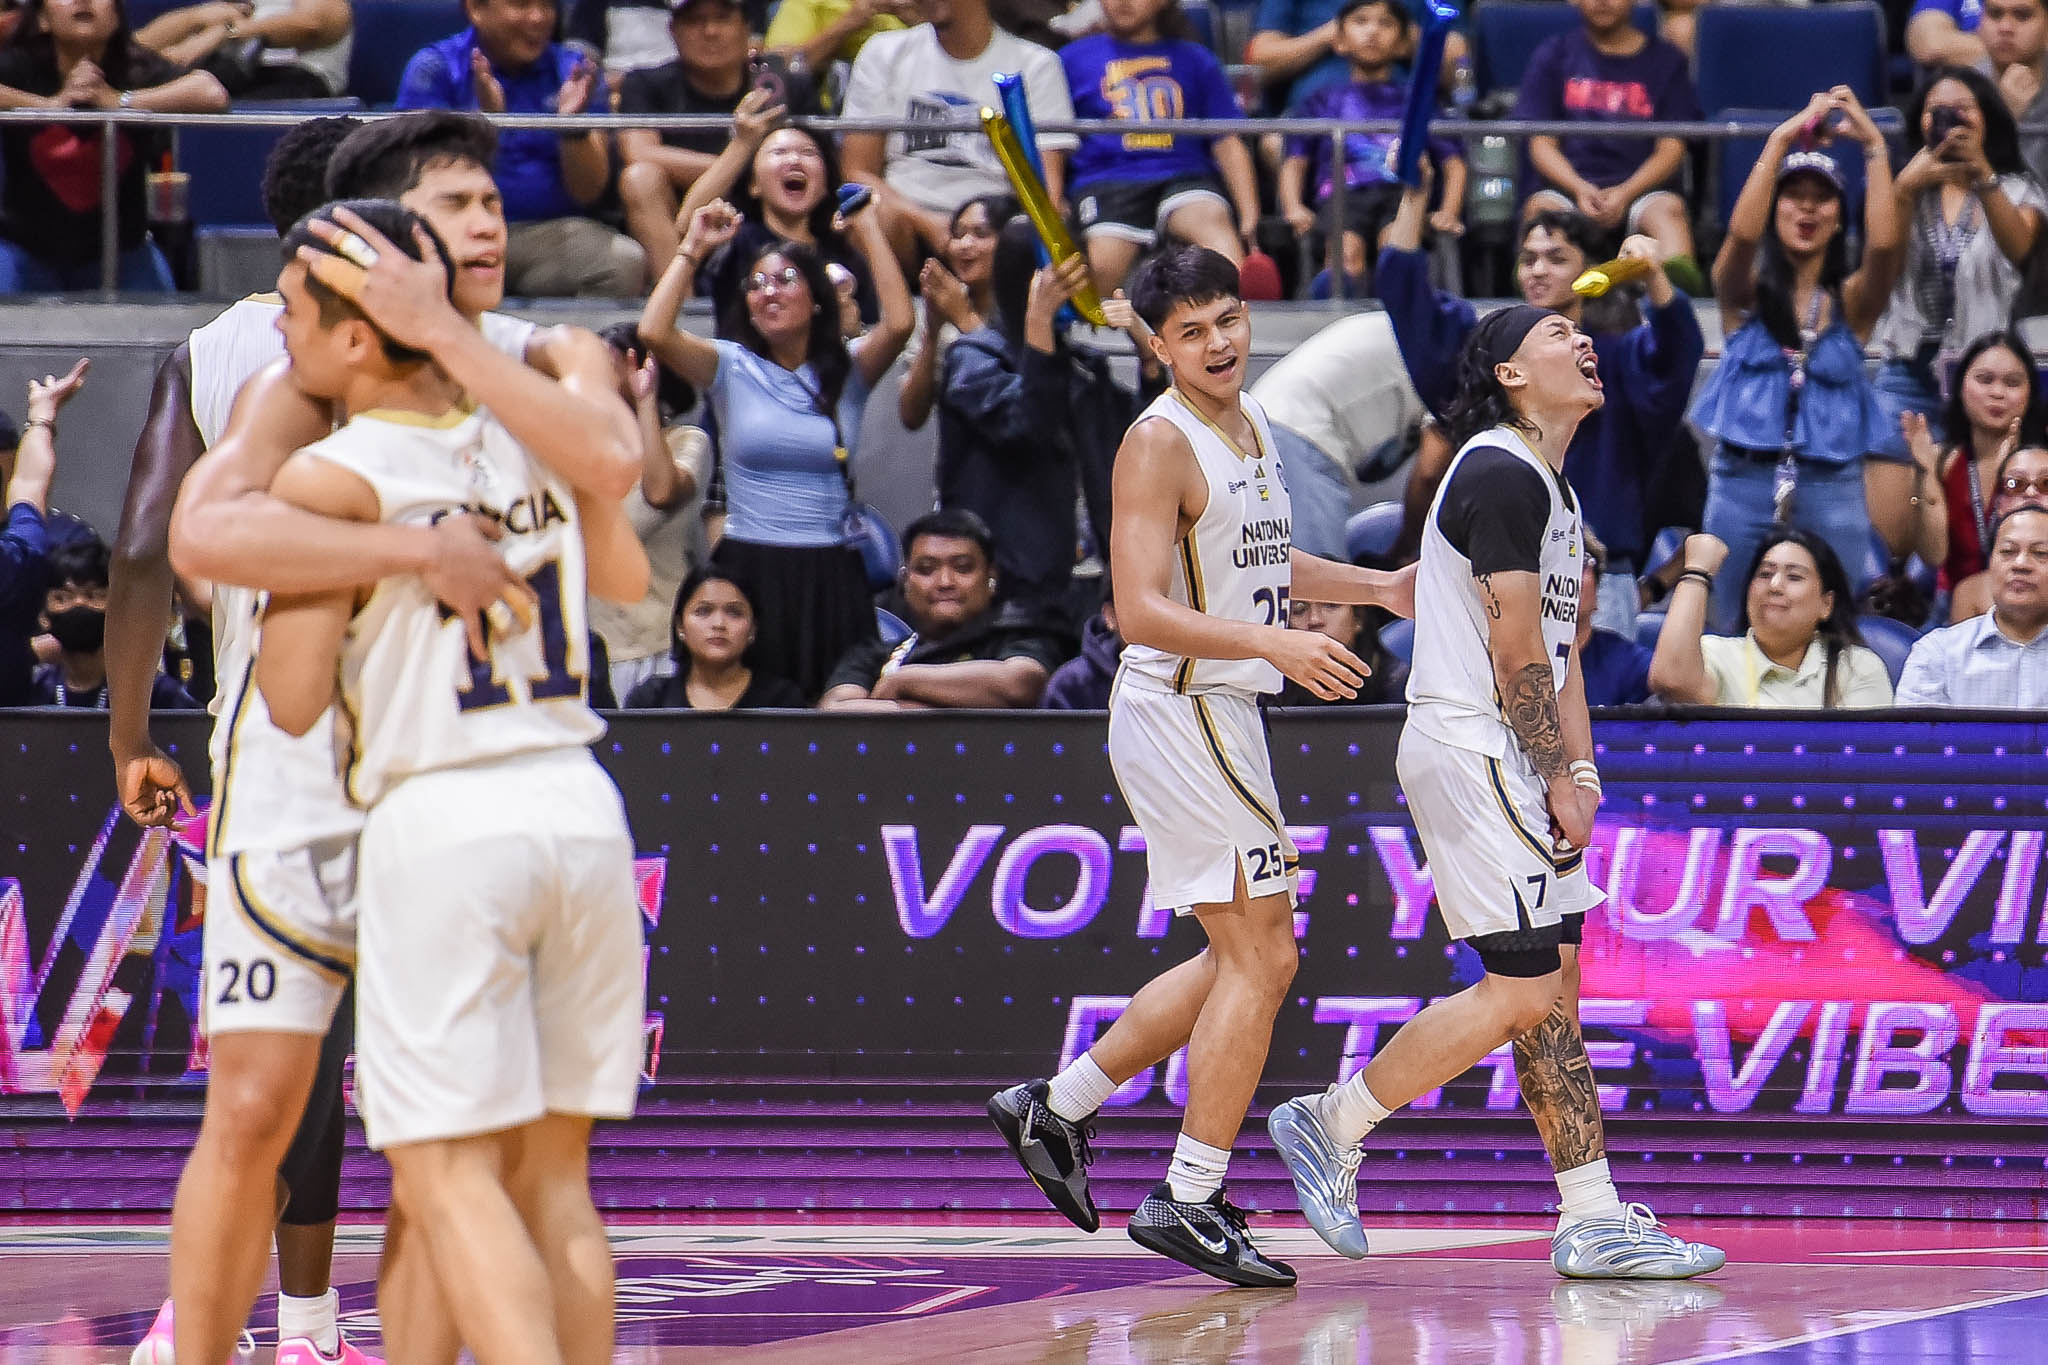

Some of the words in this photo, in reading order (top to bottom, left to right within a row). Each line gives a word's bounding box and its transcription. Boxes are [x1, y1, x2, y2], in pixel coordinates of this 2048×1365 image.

[431, 489, 568, 535] CIA
[1246, 842, 1282, 882] 25
[1367, 825, 1834, 943] YUR
[1876, 828, 2048, 945] VI
[1526, 872, 1547, 909] 7
[218, 960, 276, 1004] 20
[1692, 1000, 2048, 1117] VIBE
